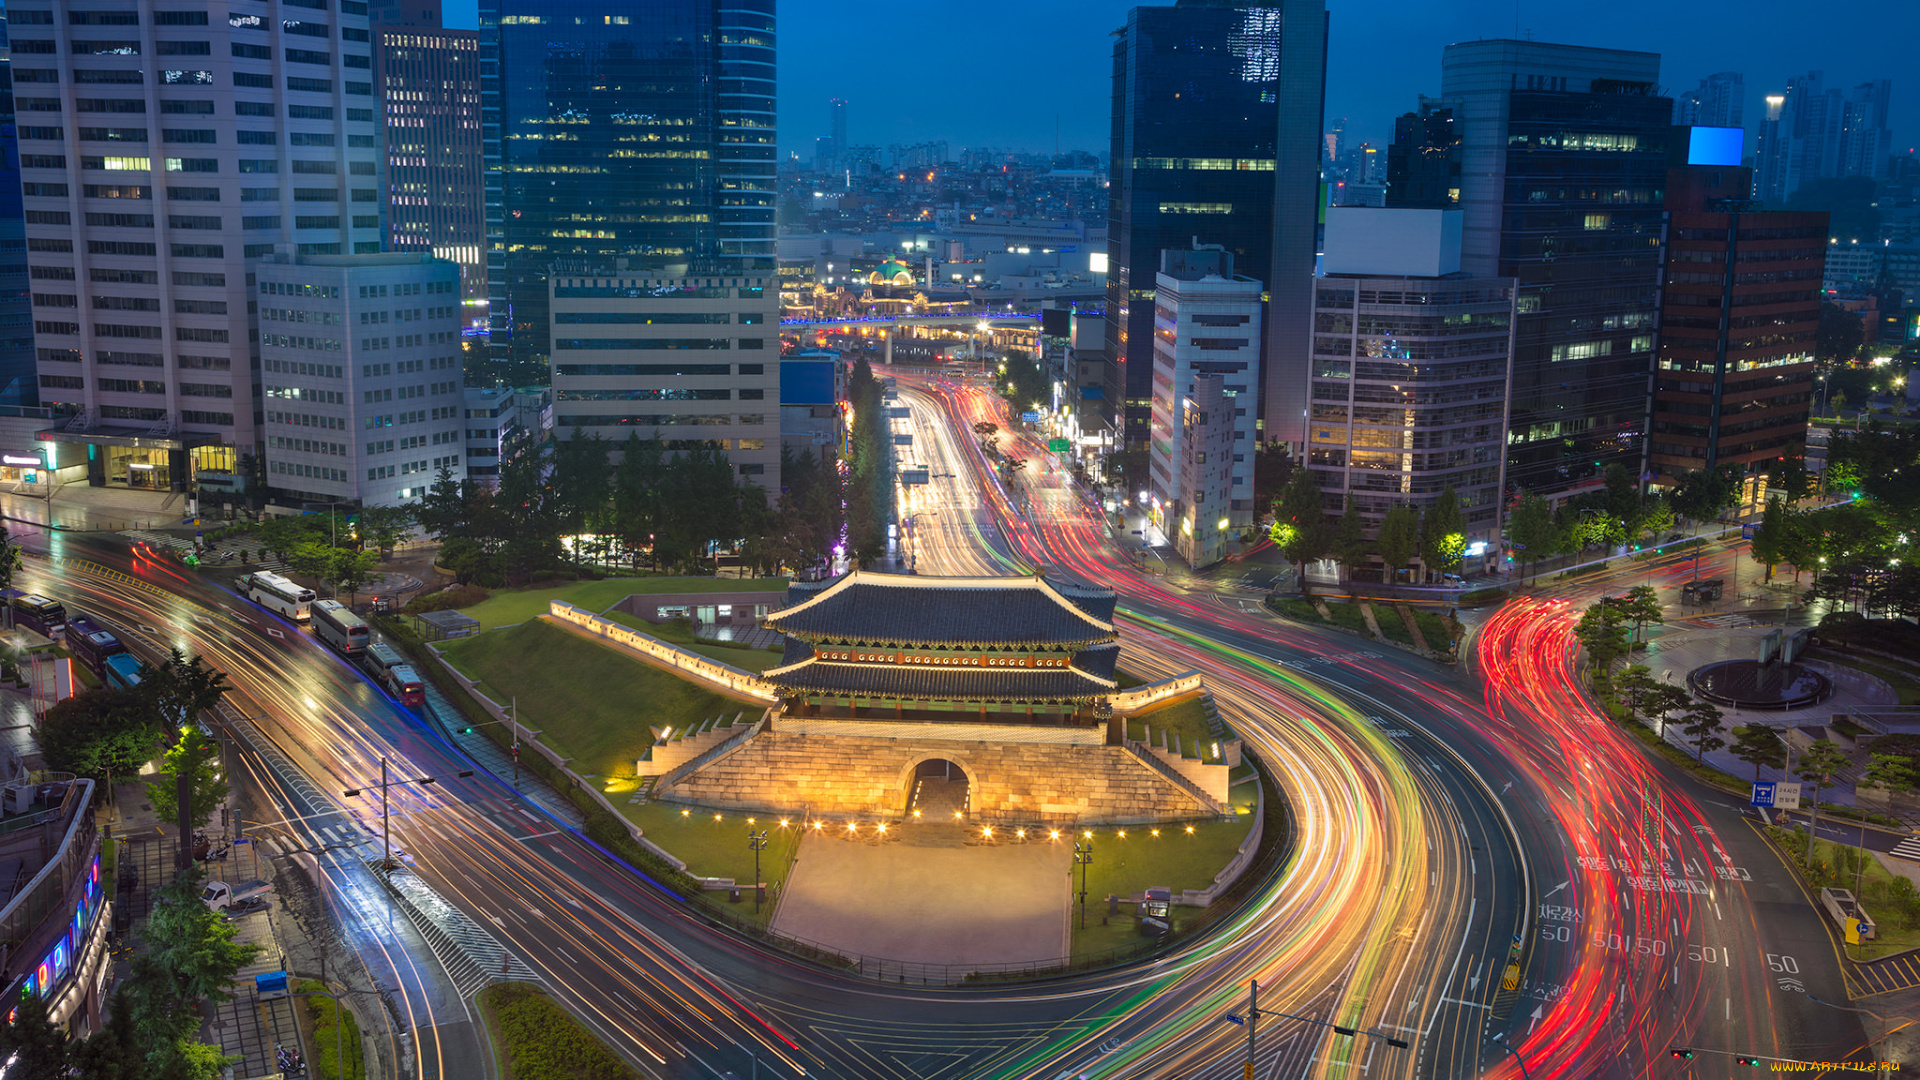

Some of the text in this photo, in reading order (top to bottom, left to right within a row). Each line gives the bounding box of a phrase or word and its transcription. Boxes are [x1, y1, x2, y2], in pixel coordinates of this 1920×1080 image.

[1542, 924, 1571, 943] 50
[1592, 931, 1621, 950] 50
[1638, 937, 1666, 957] 50
[1688, 944, 1717, 964] 50
[1766, 953, 1800, 974] 50
